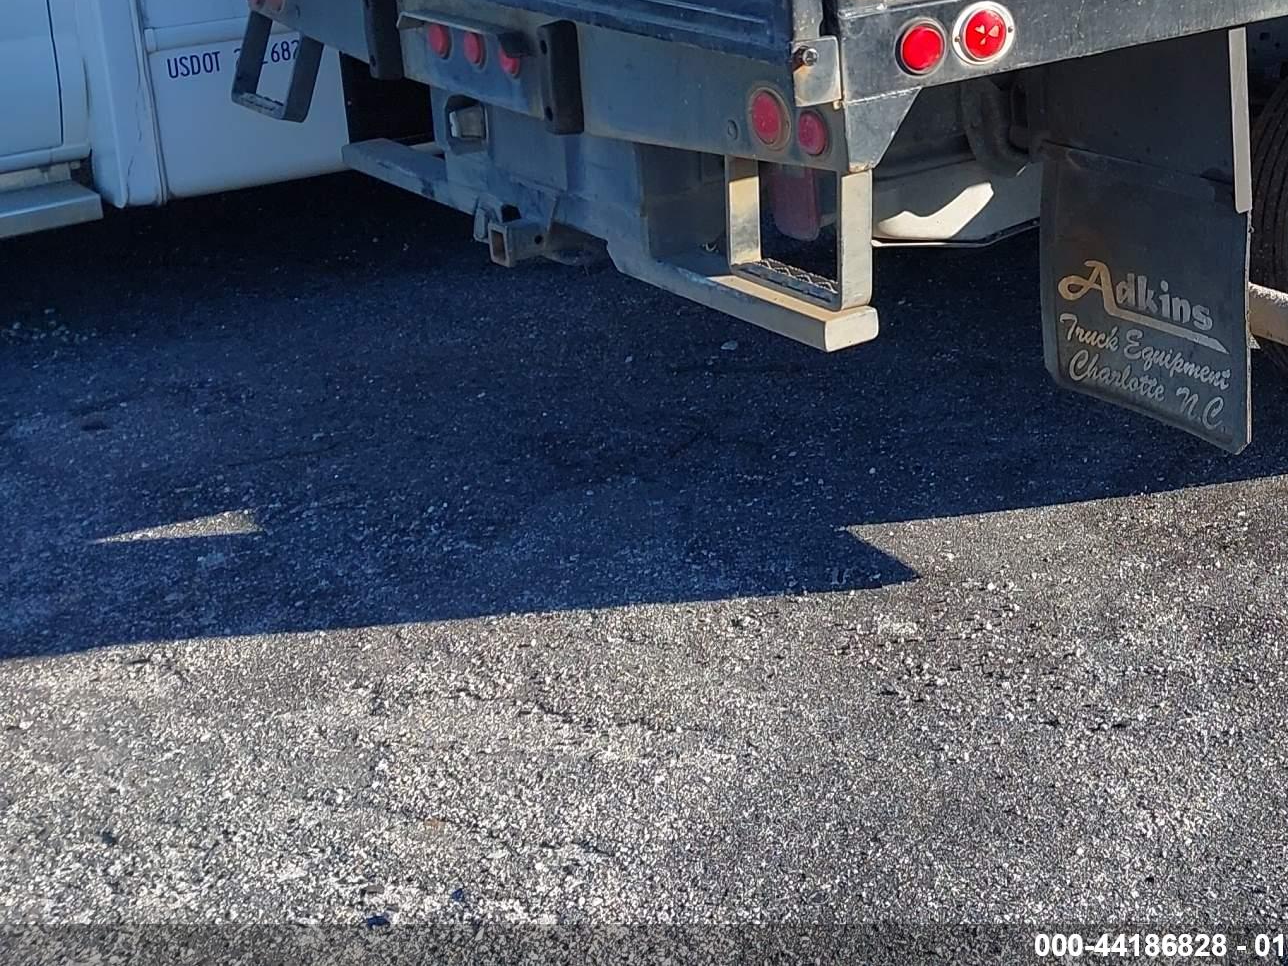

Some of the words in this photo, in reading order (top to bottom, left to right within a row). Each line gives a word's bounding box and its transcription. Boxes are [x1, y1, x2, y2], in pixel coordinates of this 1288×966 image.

[167, 50, 221, 79] USDOT
[1058, 260, 1215, 333] Adkins
[1059, 313, 1120, 352] Truck
[1123, 330, 1231, 390] Equipment
[1069, 349, 1165, 402] Charlotte
